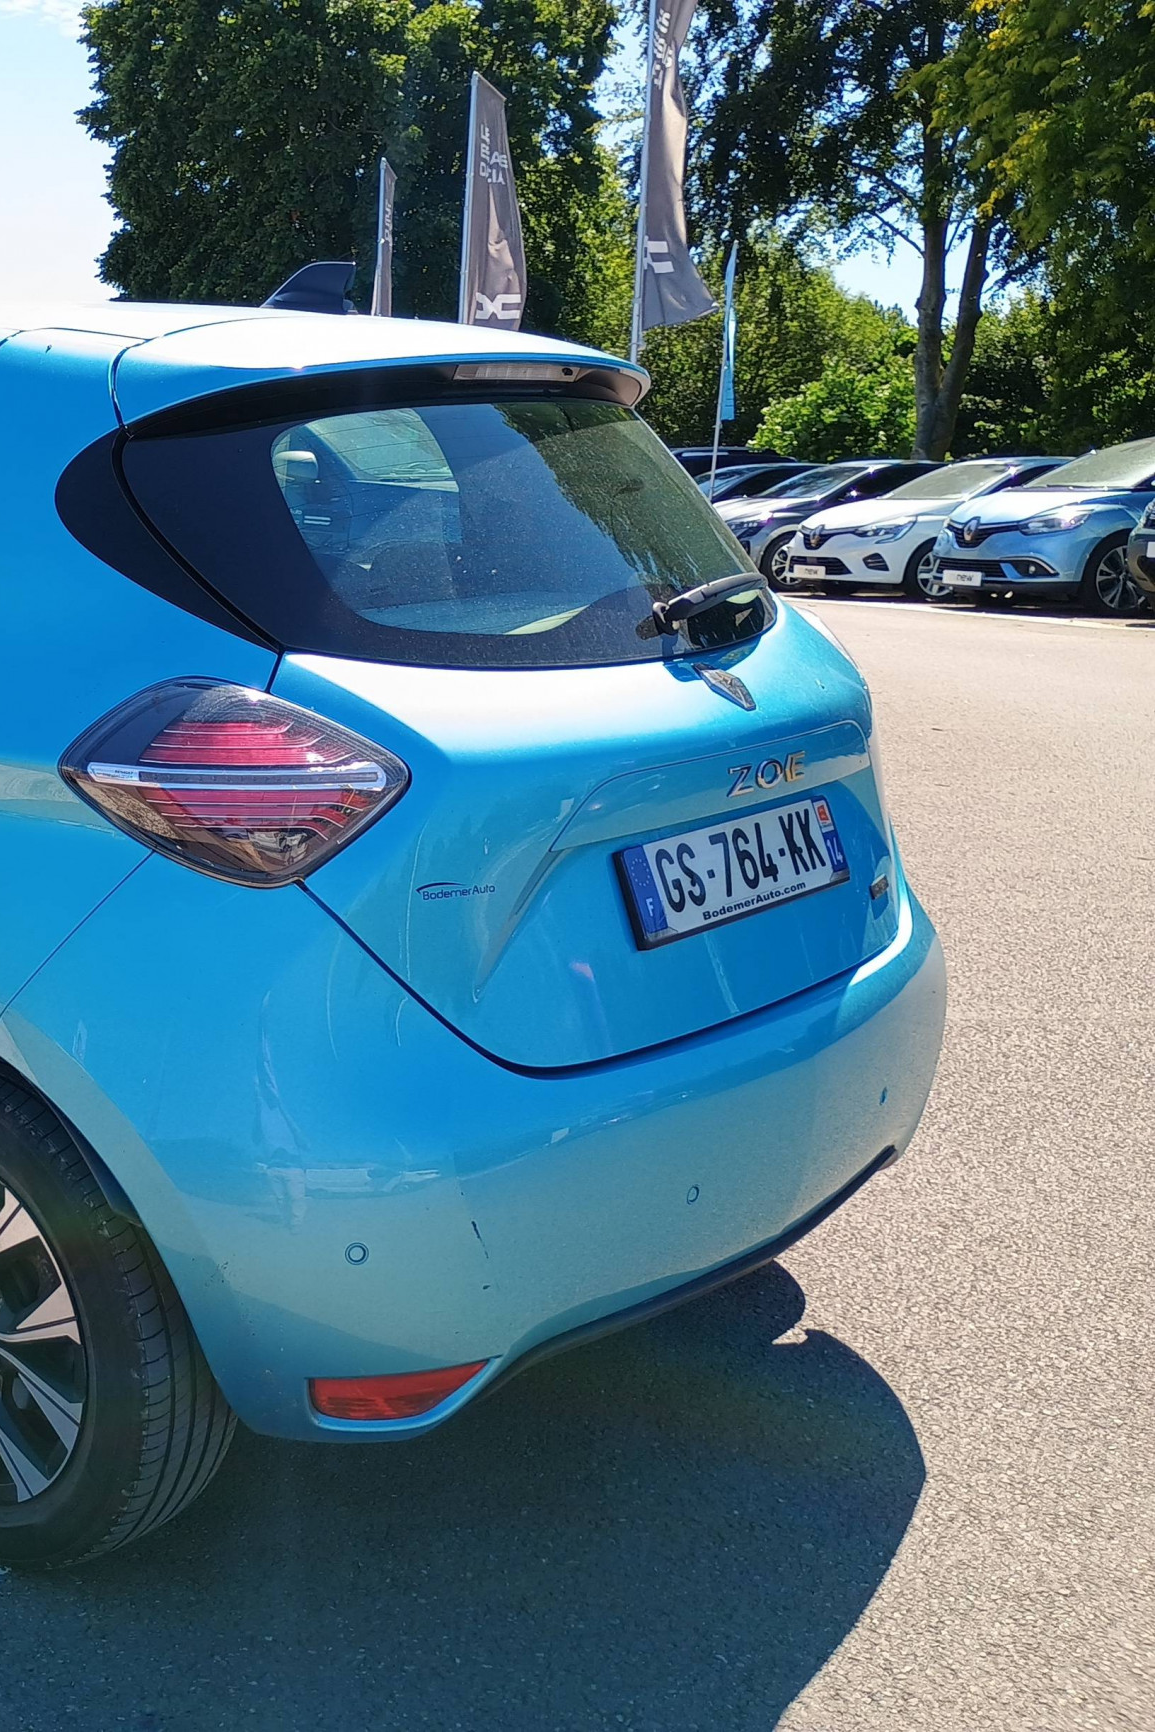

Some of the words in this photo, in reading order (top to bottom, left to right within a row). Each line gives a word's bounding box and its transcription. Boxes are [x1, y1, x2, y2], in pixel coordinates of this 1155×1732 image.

[726, 750, 806, 797] ZOE
[654, 808, 827, 913] GS-764-KK
[826, 836, 844, 866] 14
[422, 884, 496, 901] BodemerAuto
[645, 897, 655, 917] F
[702, 881, 807, 921] BodemerAuto.com
